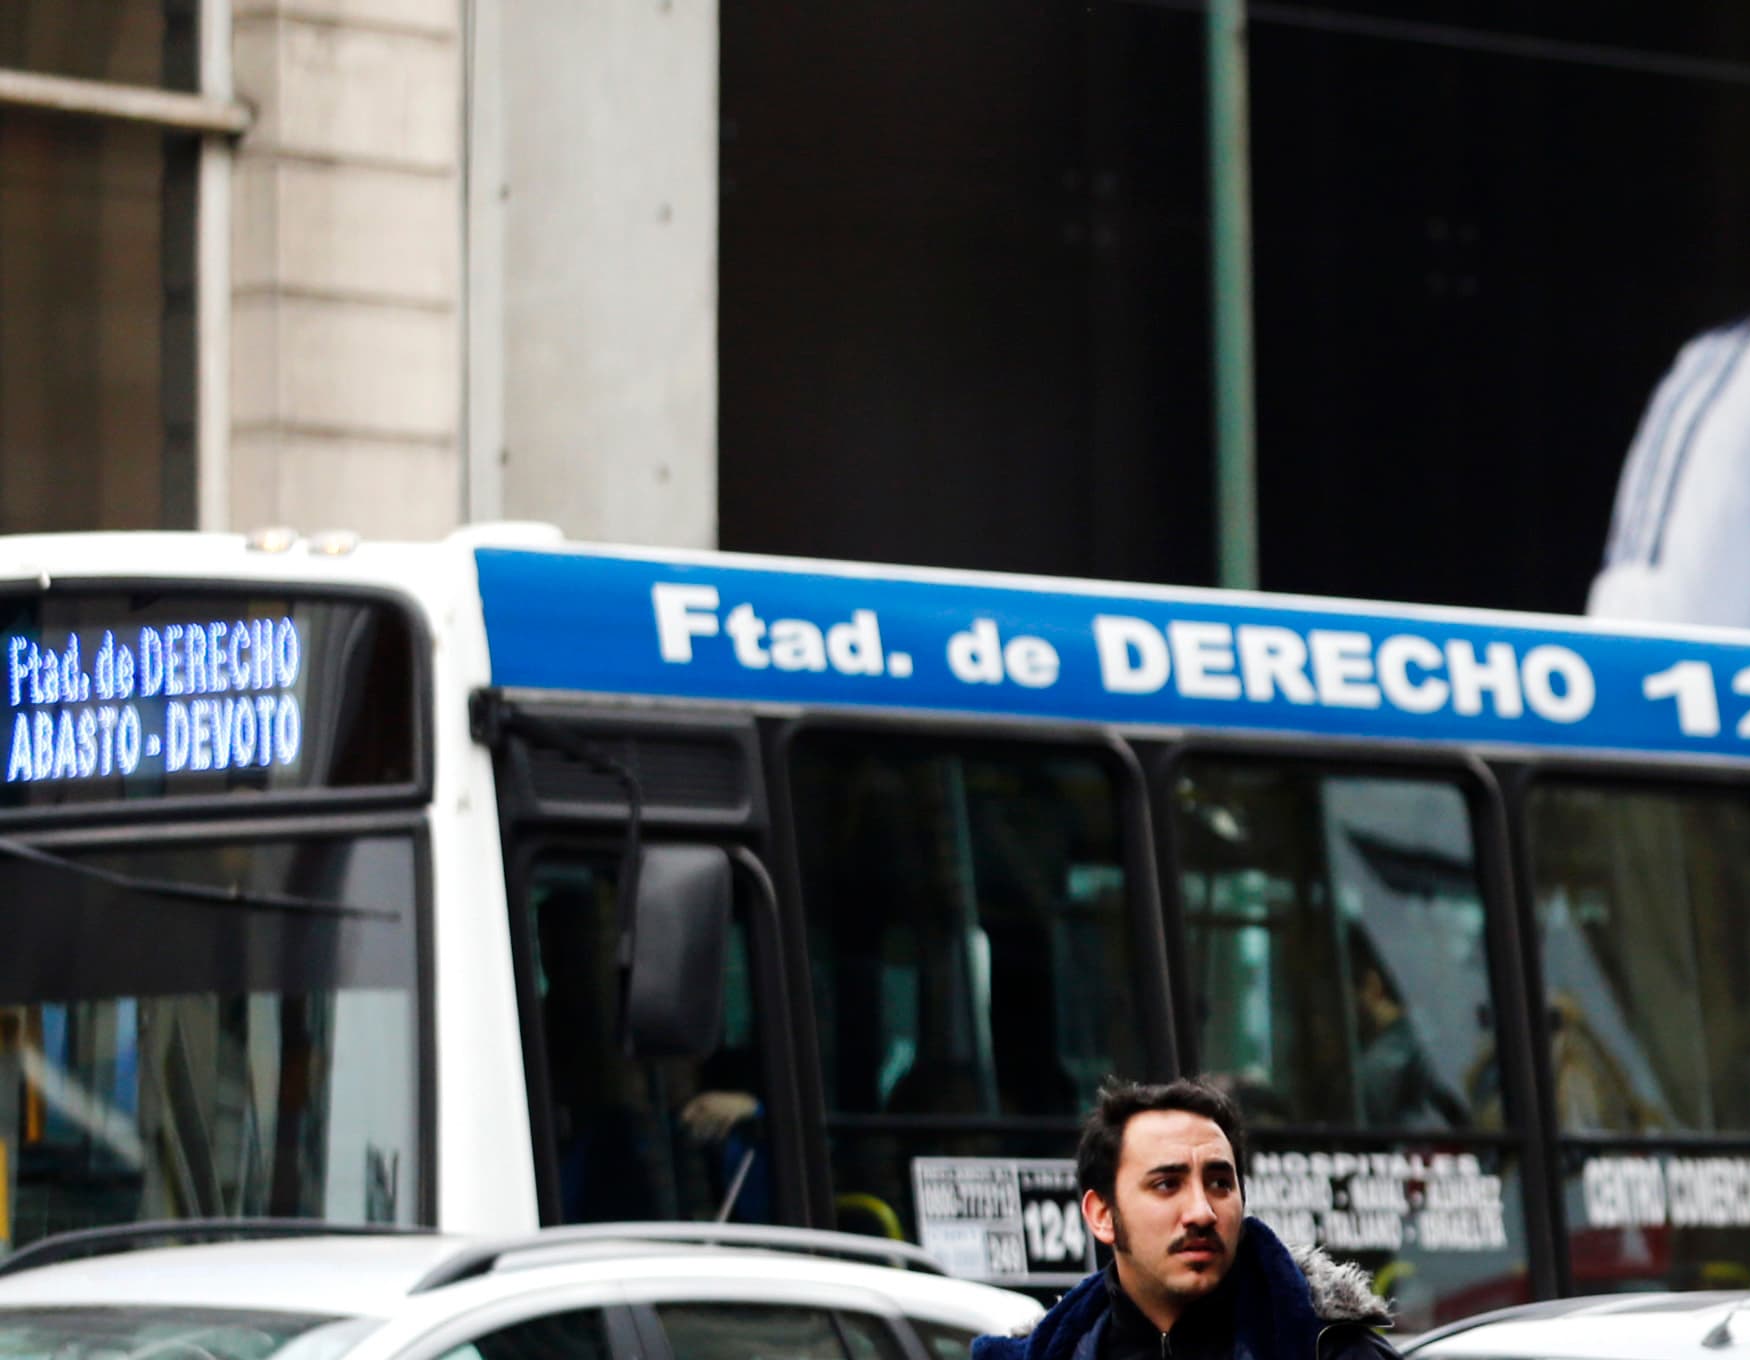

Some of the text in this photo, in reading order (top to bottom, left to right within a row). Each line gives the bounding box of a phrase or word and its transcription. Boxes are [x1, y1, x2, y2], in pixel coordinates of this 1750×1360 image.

[95, 629, 134, 699] de
[140, 616, 298, 697] DERECHO
[651, 581, 913, 678] Ftad.
[947, 617, 1059, 688] de
[1092, 615, 1595, 723] DERECHO
[7, 704, 141, 782] ABASTO
[165, 694, 299, 772] DEVOTO
[1024, 1200, 1086, 1261] 124
